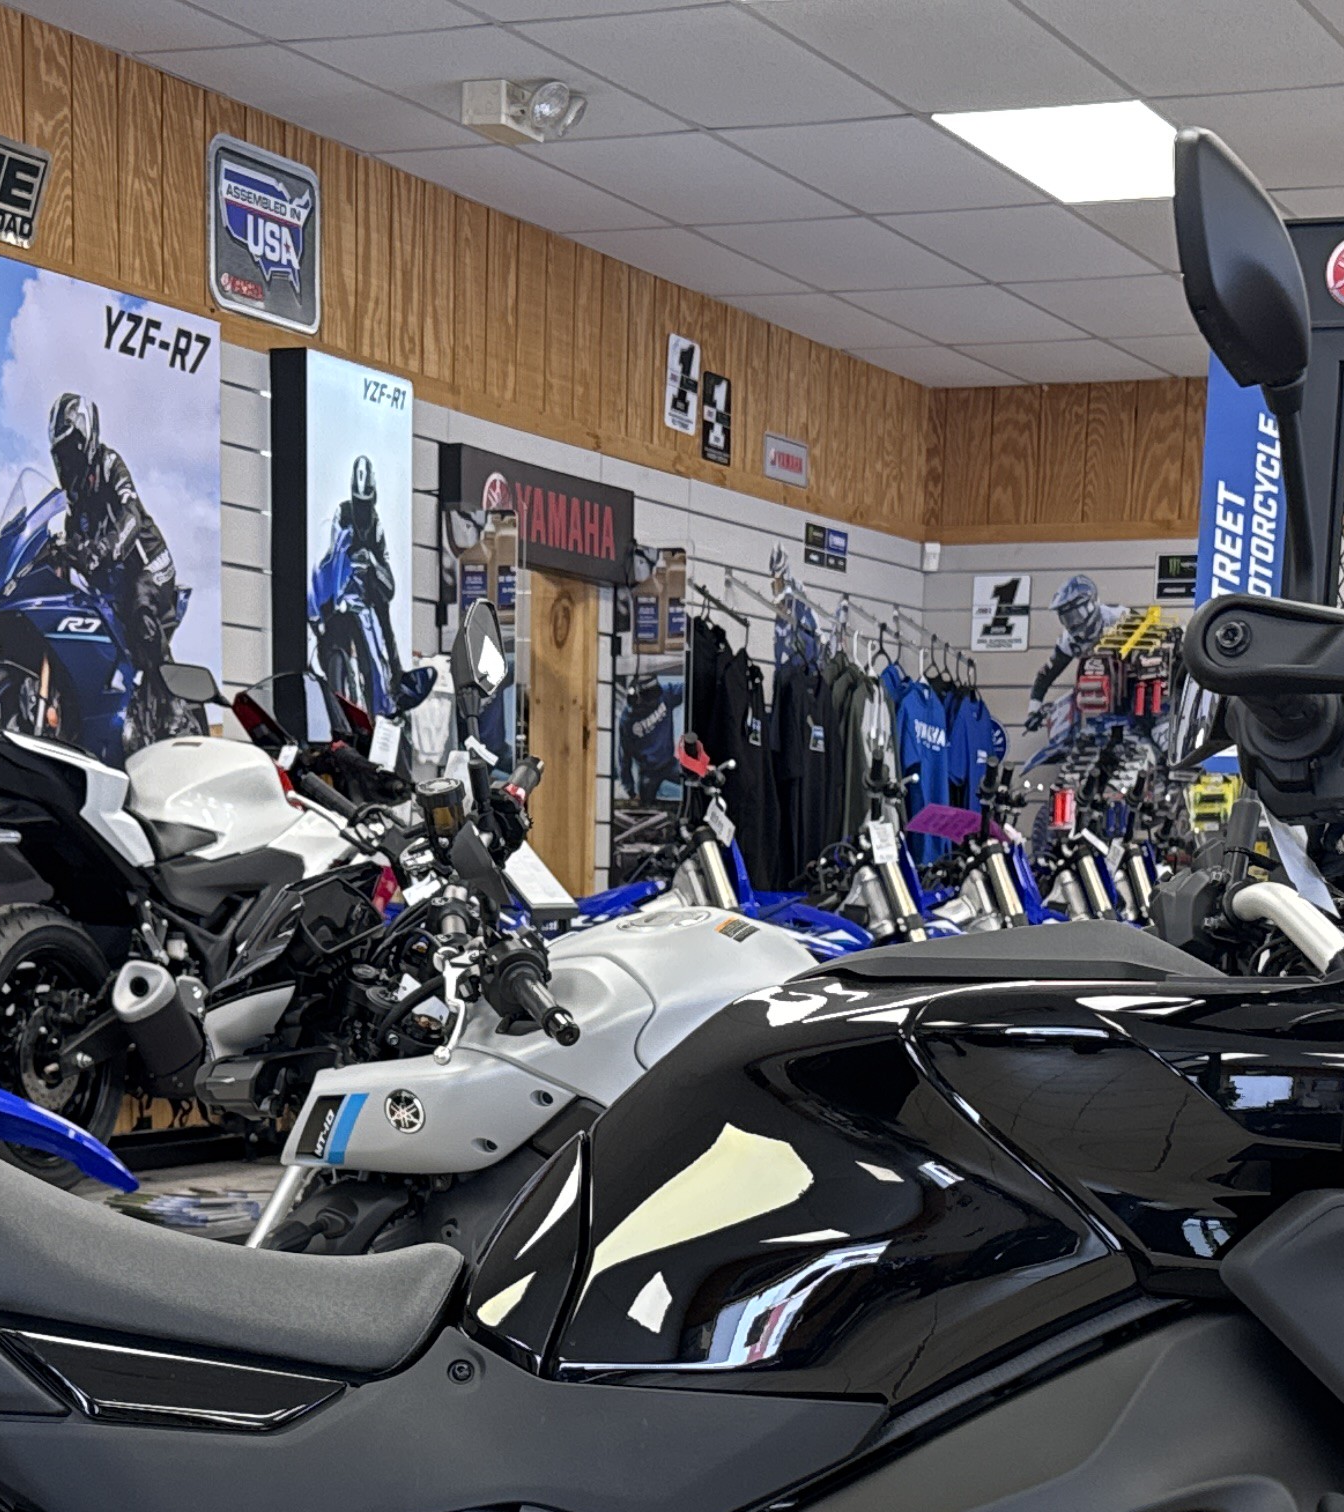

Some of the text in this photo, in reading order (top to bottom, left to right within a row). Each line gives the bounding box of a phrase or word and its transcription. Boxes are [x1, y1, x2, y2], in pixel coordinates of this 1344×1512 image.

[226, 183, 302, 223] ASSEMBLED IN
[246, 213, 301, 270] USA
[104, 306, 211, 374] YZF-R7
[362, 378, 407, 411] YZF-R1
[515, 481, 617, 562] YAMAHA
[1248, 412, 1281, 599] OTORCYCLE
[1211, 480, 1246, 599] TREET
[57, 616, 103, 633] R7
[314, 1108, 336, 1157] MT-10
